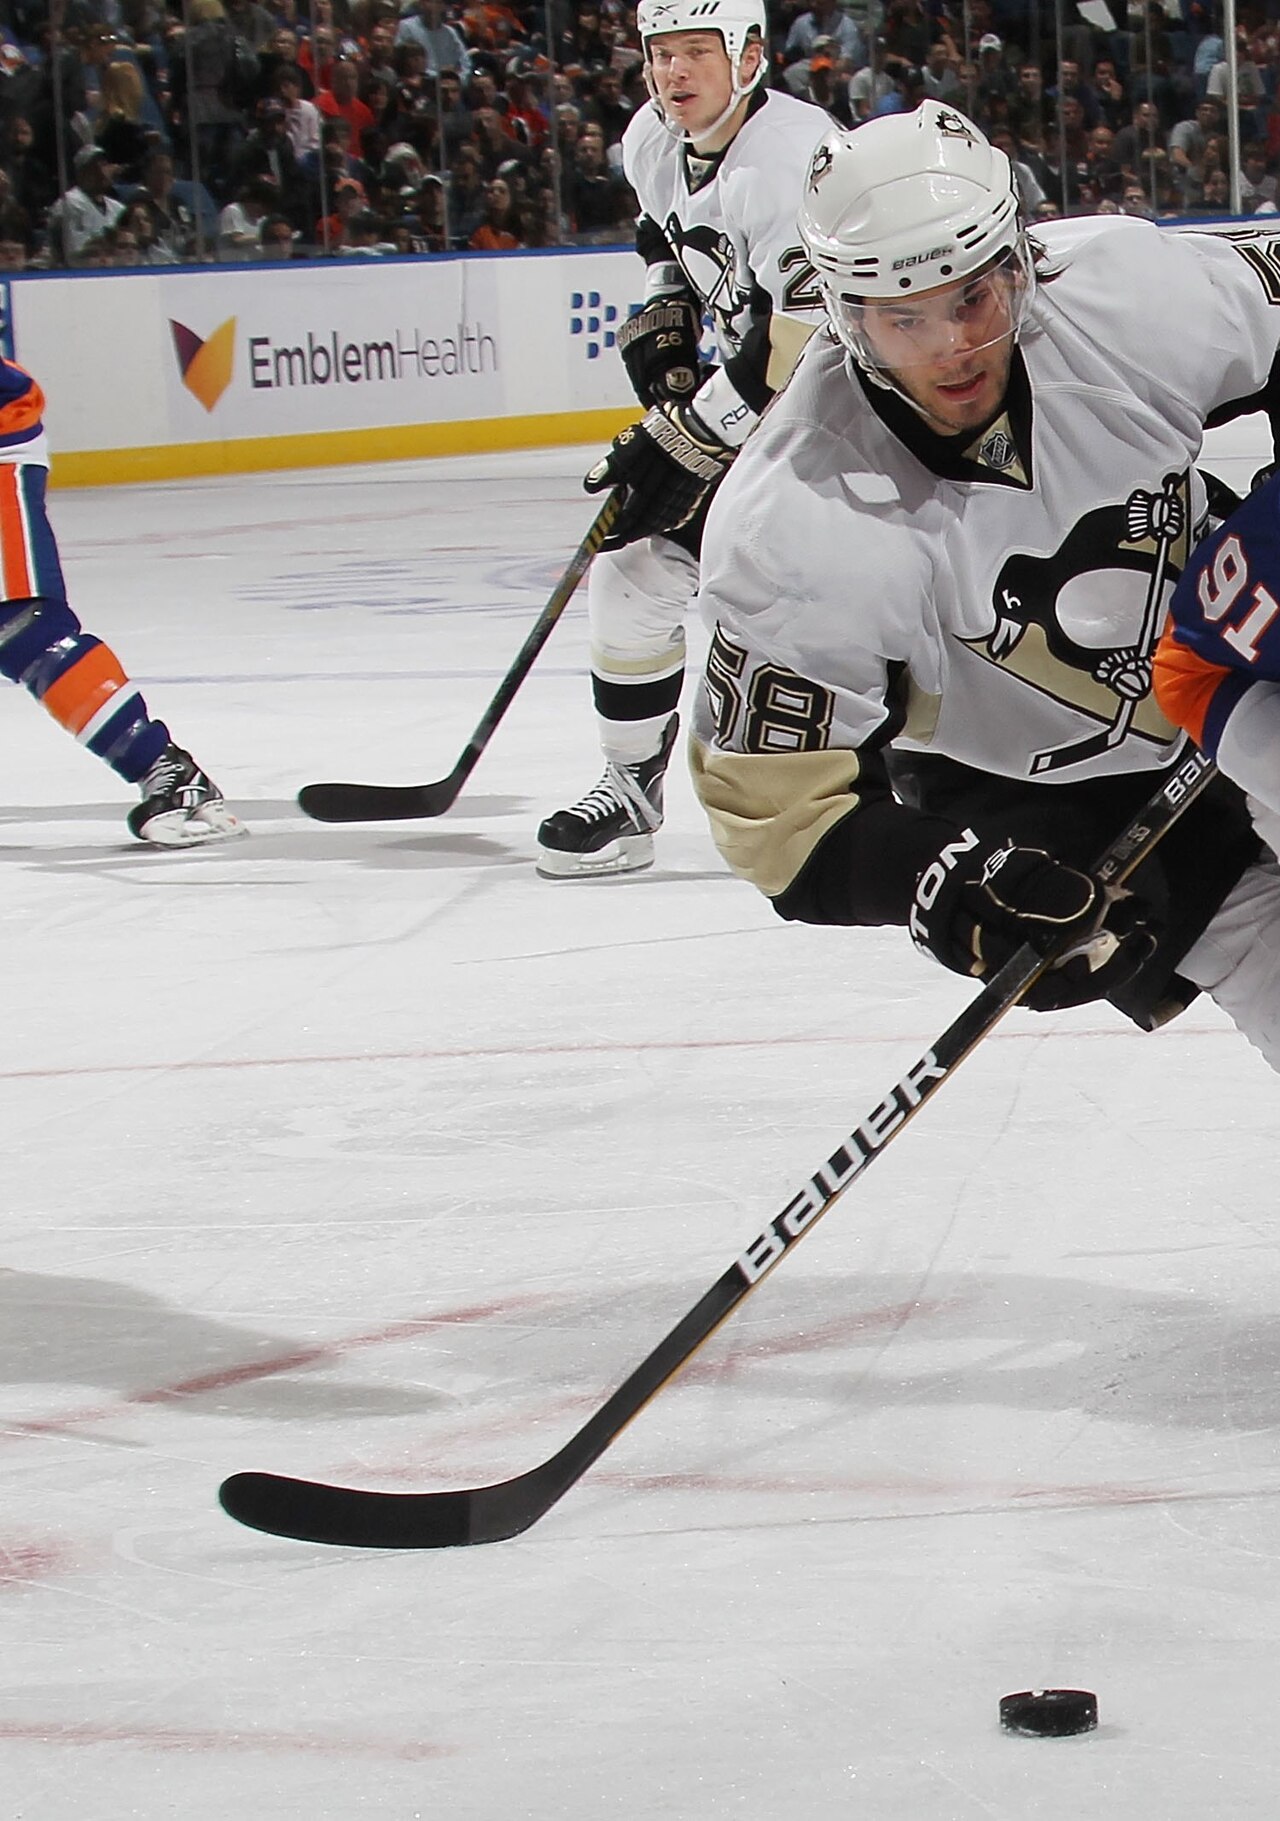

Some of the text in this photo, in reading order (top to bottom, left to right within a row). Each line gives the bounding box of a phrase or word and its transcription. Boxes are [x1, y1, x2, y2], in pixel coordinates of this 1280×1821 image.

[249, 322, 498, 388] EmblemHealth
[656, 332, 683, 349] 26
[1197, 533, 1280, 663] 91
[704, 626, 836, 753] 58
[910, 828, 980, 964] TON
[736, 1050, 948, 1285] BAUER
